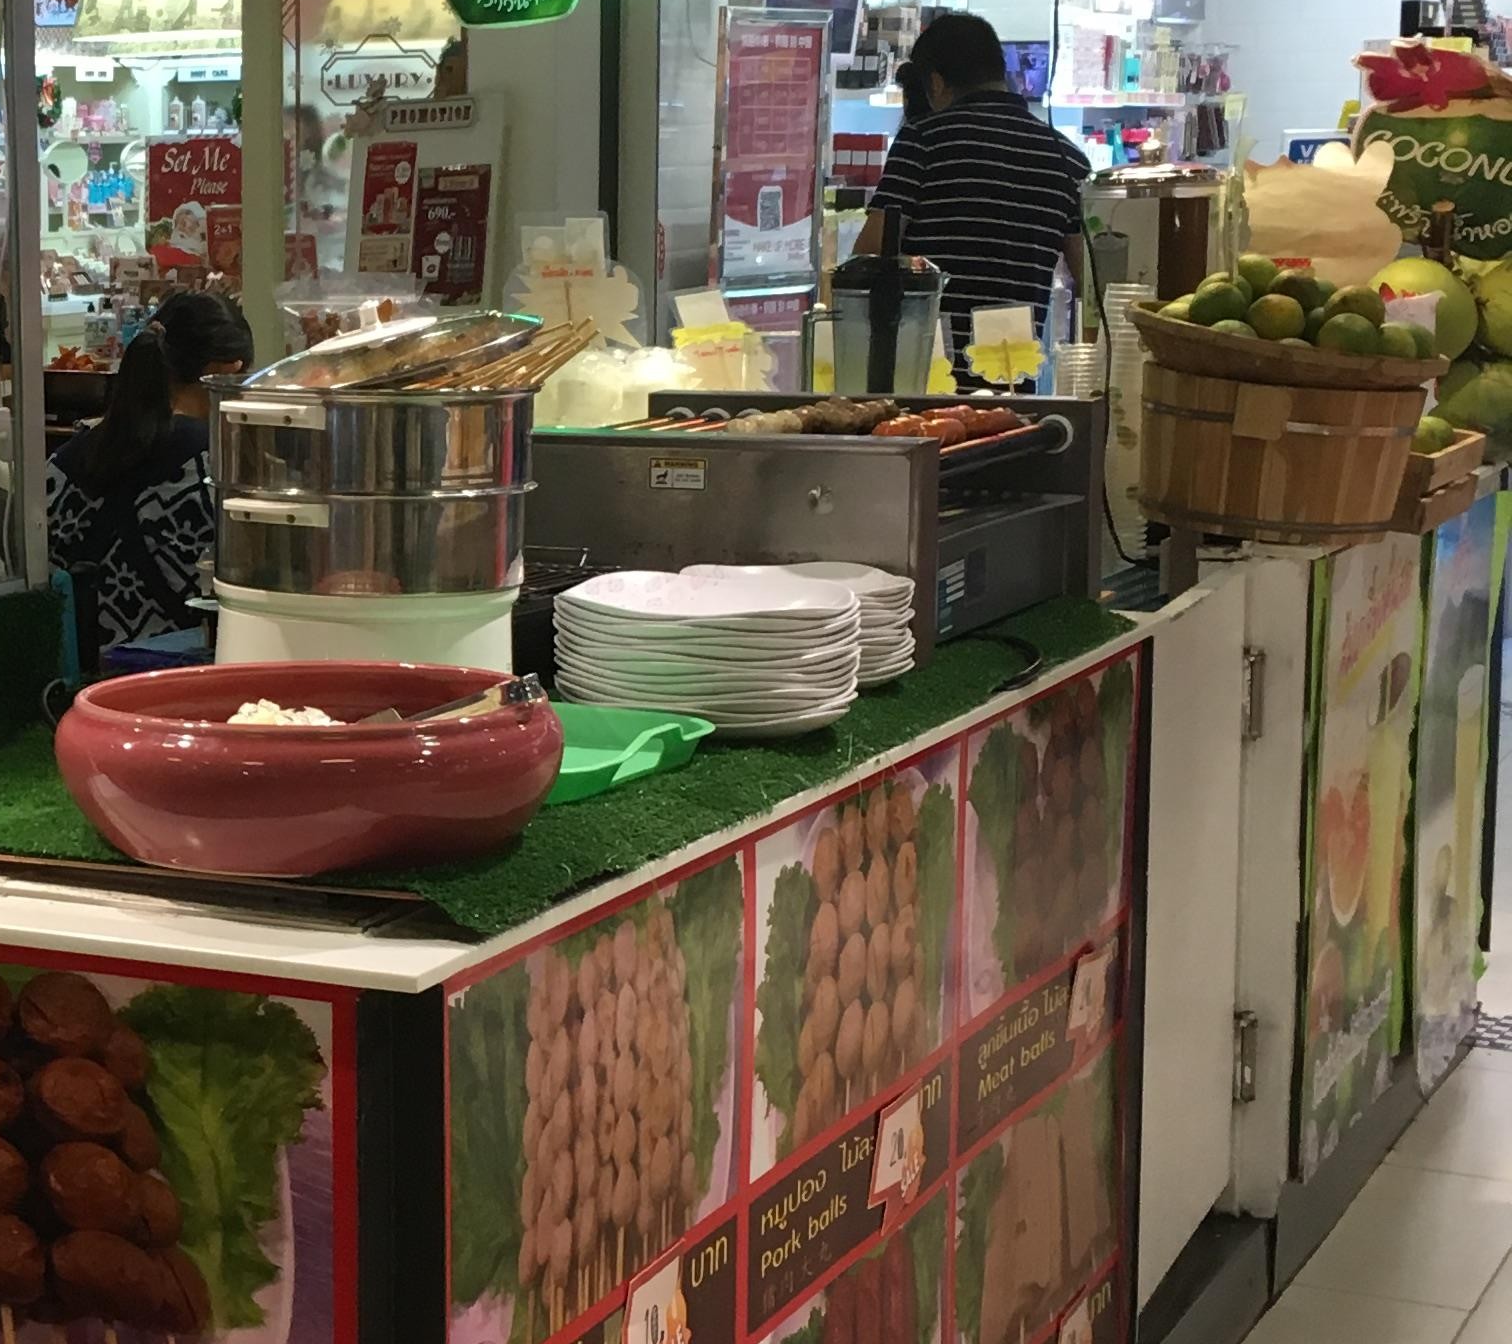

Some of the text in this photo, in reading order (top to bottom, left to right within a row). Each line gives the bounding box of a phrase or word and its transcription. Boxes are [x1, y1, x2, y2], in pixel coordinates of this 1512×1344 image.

[391, 104, 472, 125] PROMOTION
[978, 1030, 1056, 1102] Meat balls
[761, 1194, 848, 1278] Pork balls
